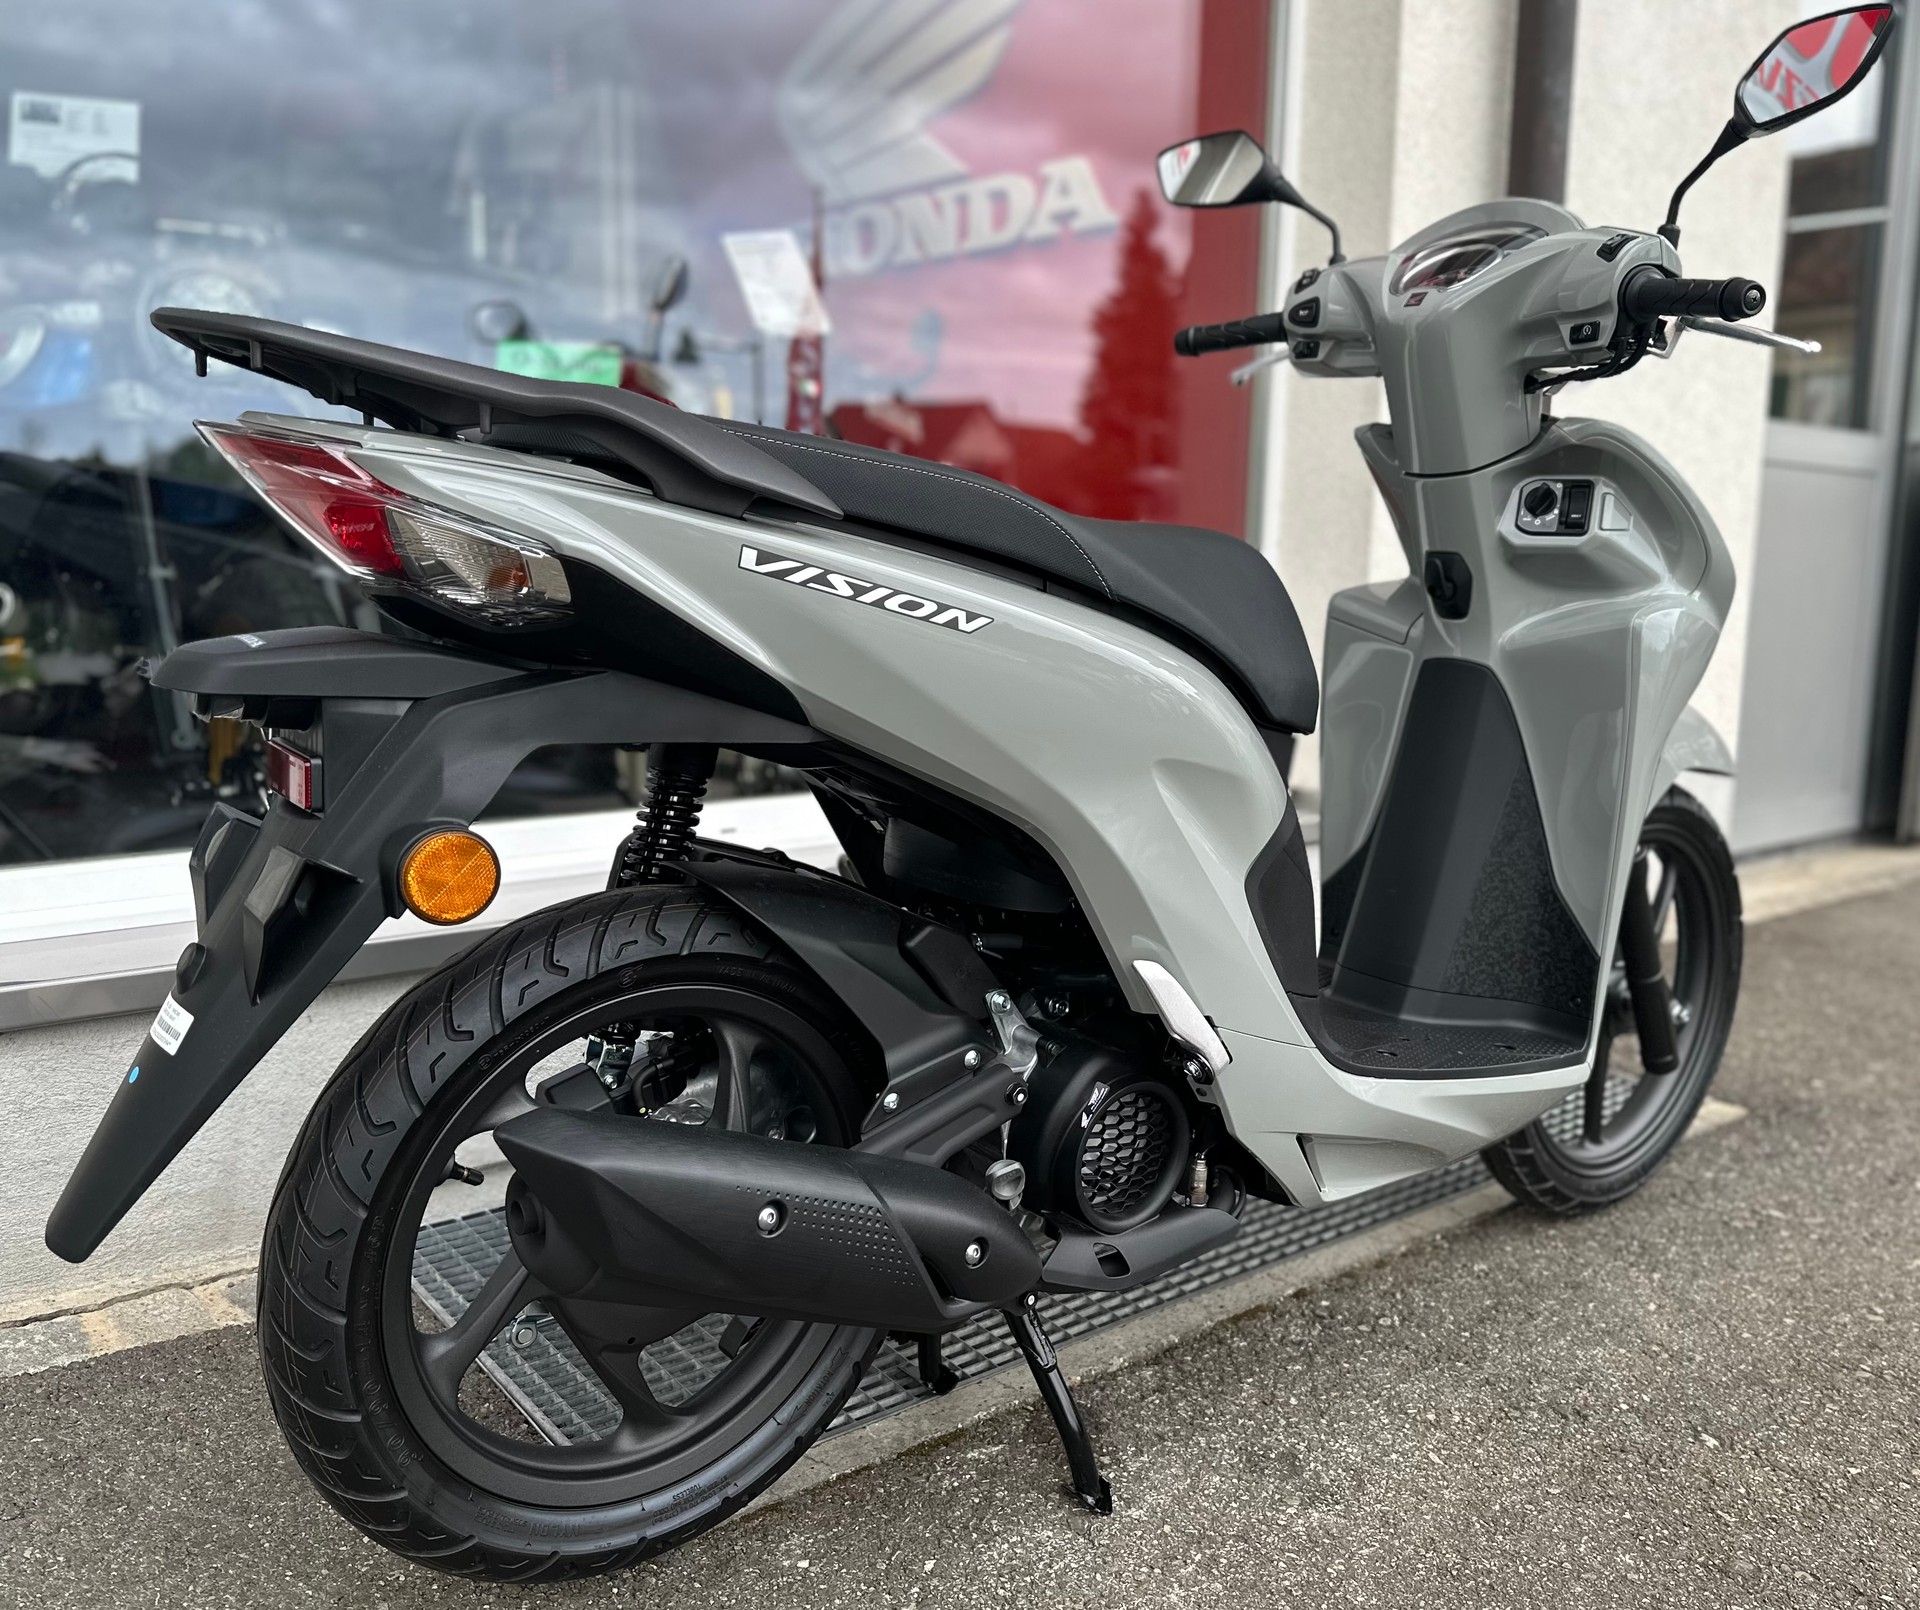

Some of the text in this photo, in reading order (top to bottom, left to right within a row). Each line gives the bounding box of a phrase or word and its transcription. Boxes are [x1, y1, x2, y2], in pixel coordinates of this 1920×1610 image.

[739, 546, 993, 632] VISION
[803, 1370, 834, 1408] ROTATION
[672, 1483, 702, 1501] TUBELESS
[529, 1522, 581, 1538] NYLON
